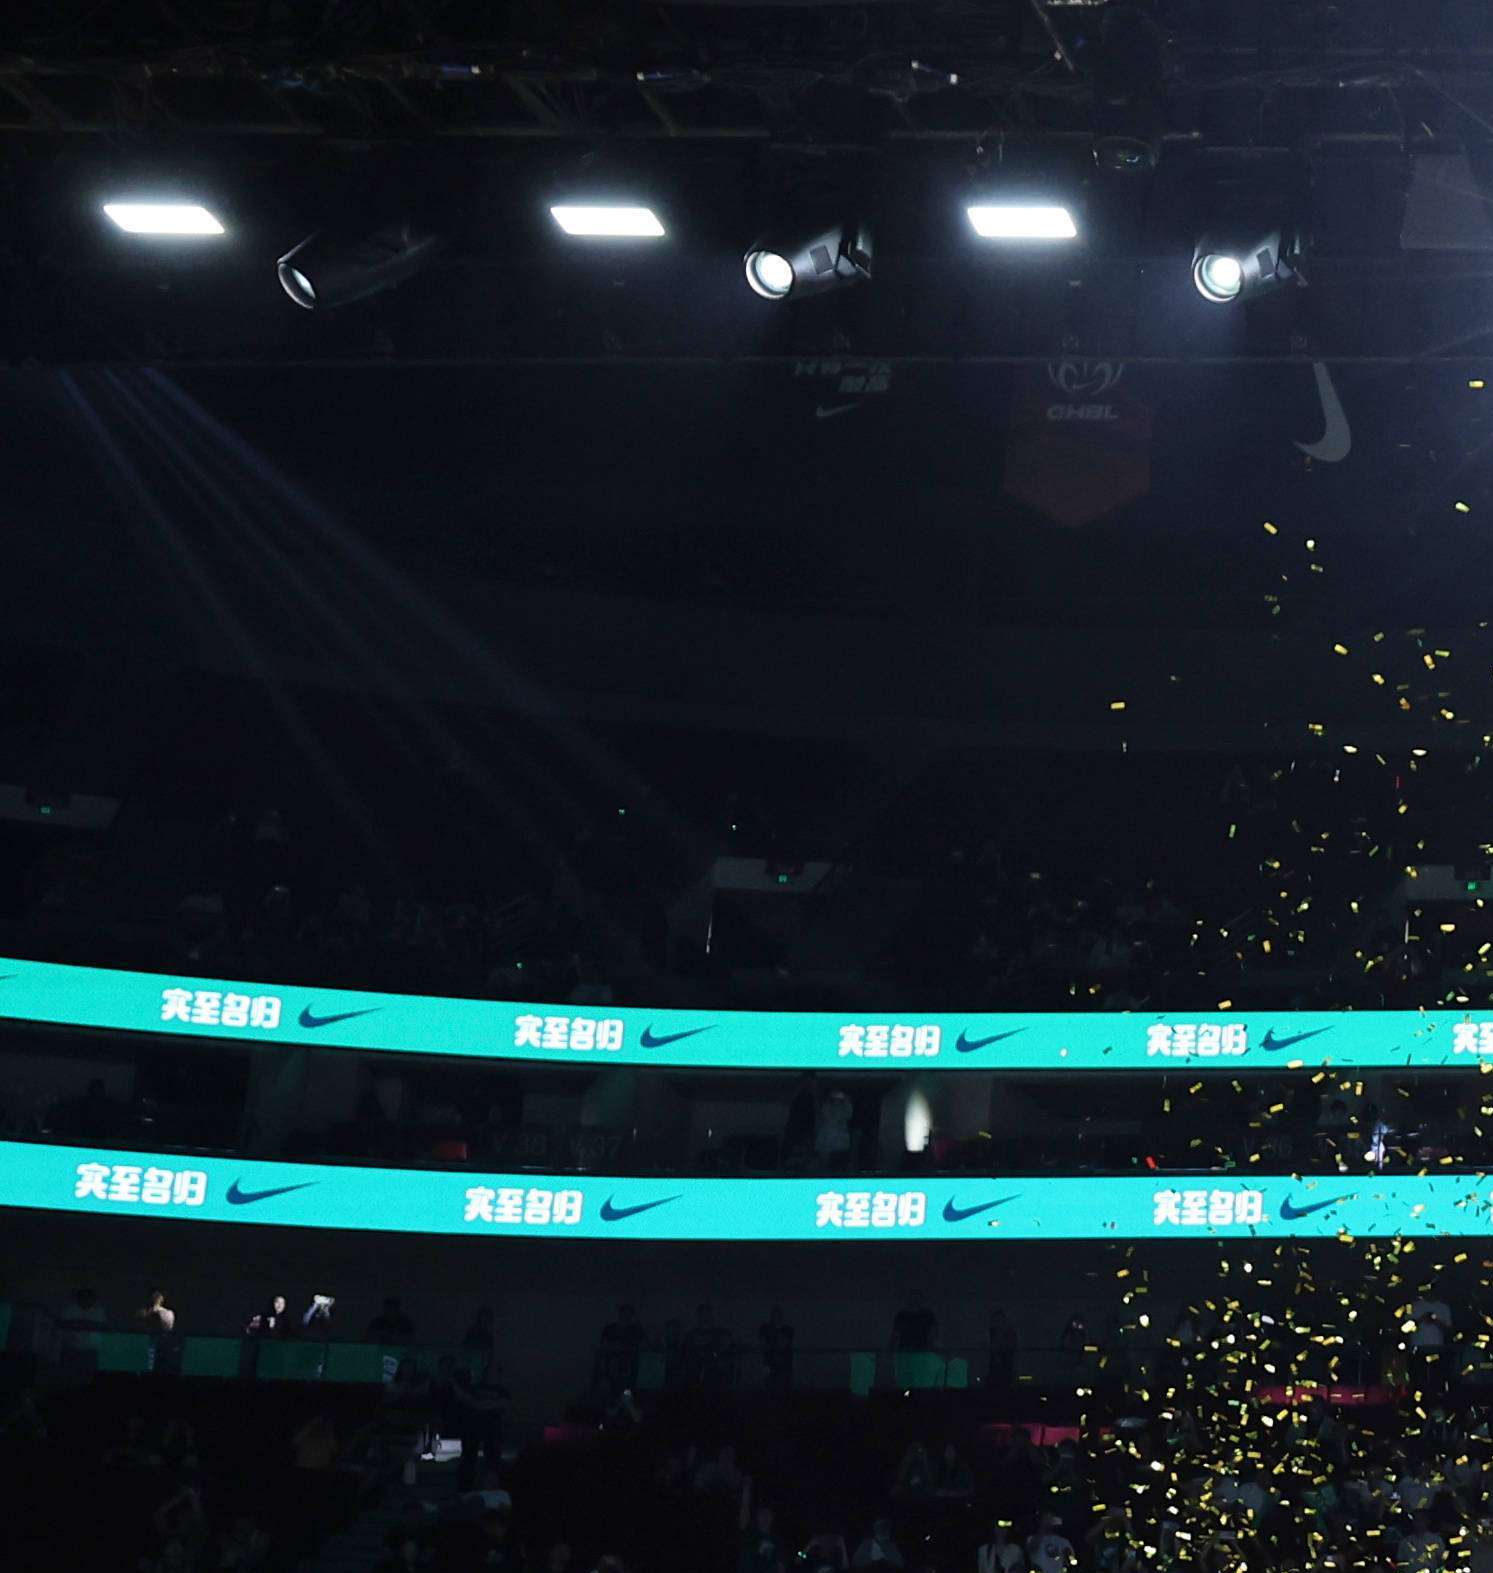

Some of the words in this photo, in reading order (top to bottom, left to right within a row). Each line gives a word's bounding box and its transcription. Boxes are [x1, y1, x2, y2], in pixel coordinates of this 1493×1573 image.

[161, 988, 282, 1028] 实至名归
[515, 1014, 624, 1050] 实至名归
[838, 1024, 941, 1057] 实至名归
[75, 1163, 207, 1205] 实至名归
[464, 1186, 583, 1224] 实至名归
[816, 1191, 926, 1227] 实至名归
